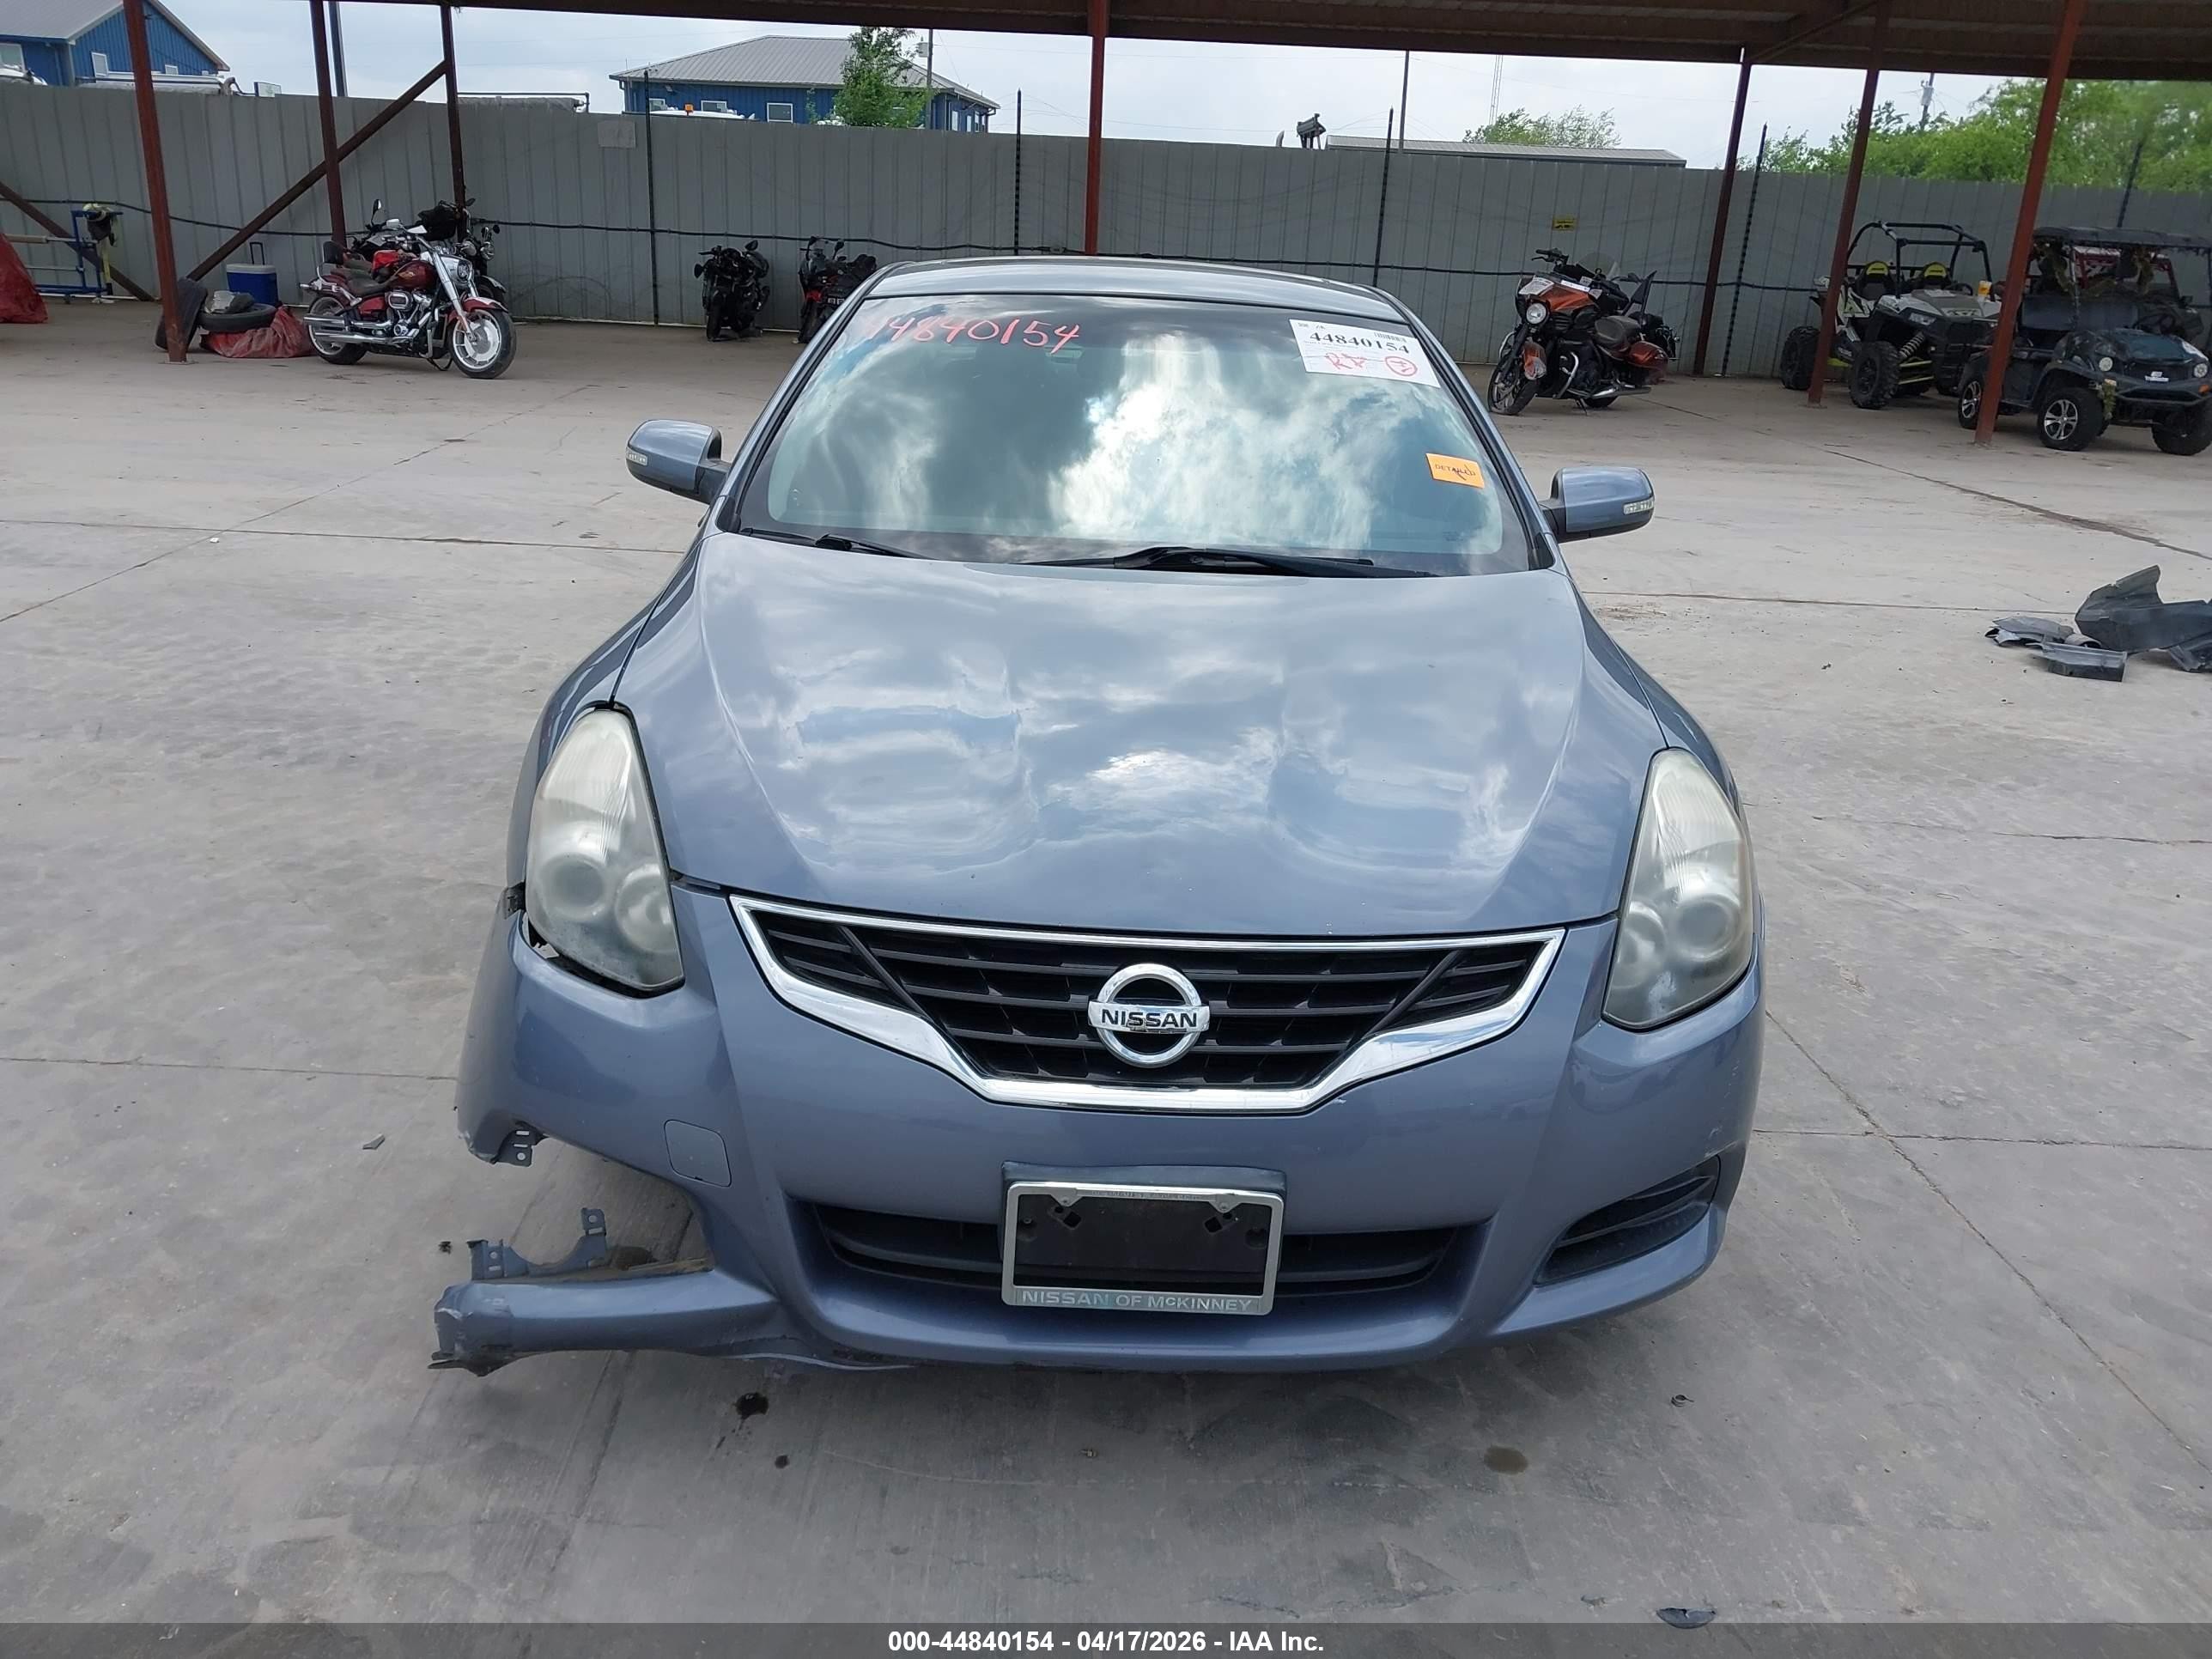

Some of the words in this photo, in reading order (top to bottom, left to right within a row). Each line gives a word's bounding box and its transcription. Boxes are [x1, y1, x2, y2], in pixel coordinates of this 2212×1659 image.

[863, 315, 1079, 355] 4840154
[1310, 331, 1410, 354] 44840154
[1102, 1009, 1197, 1028] NISSAN
[1022, 1290, 1109, 1307] NISSAN
[1115, 1294, 1142, 1308] OF
